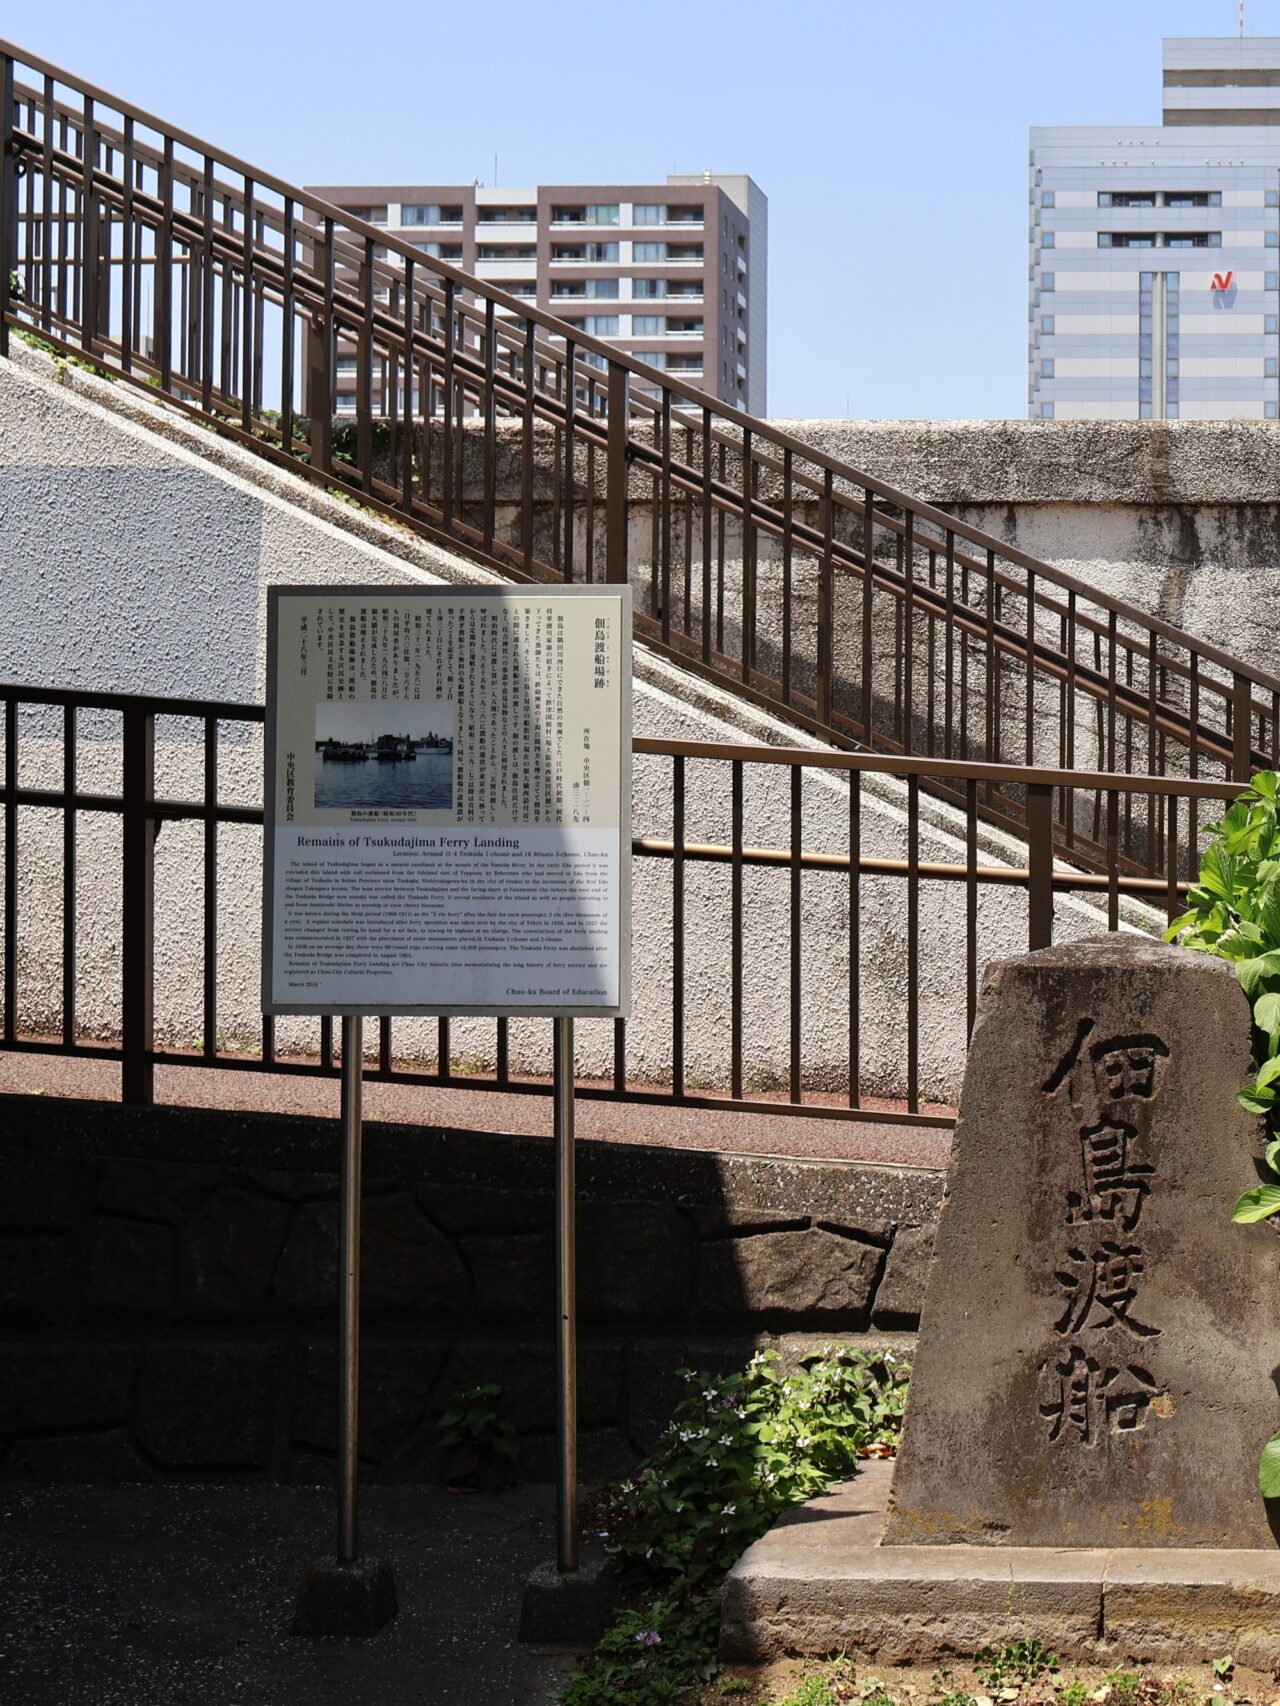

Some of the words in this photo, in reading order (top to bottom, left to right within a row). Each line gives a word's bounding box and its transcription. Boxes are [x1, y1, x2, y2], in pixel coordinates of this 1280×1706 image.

[594, 618, 605, 688] 佃島渡船場跡
[286, 752, 295, 821] 中央区教育委員会
[297, 836, 345, 846] Remains
[349, 836, 359, 847] of
[364, 836, 436, 849] Tsukudajima
[440, 837, 469, 849] Ferry
[474, 837, 519, 850] Landing
